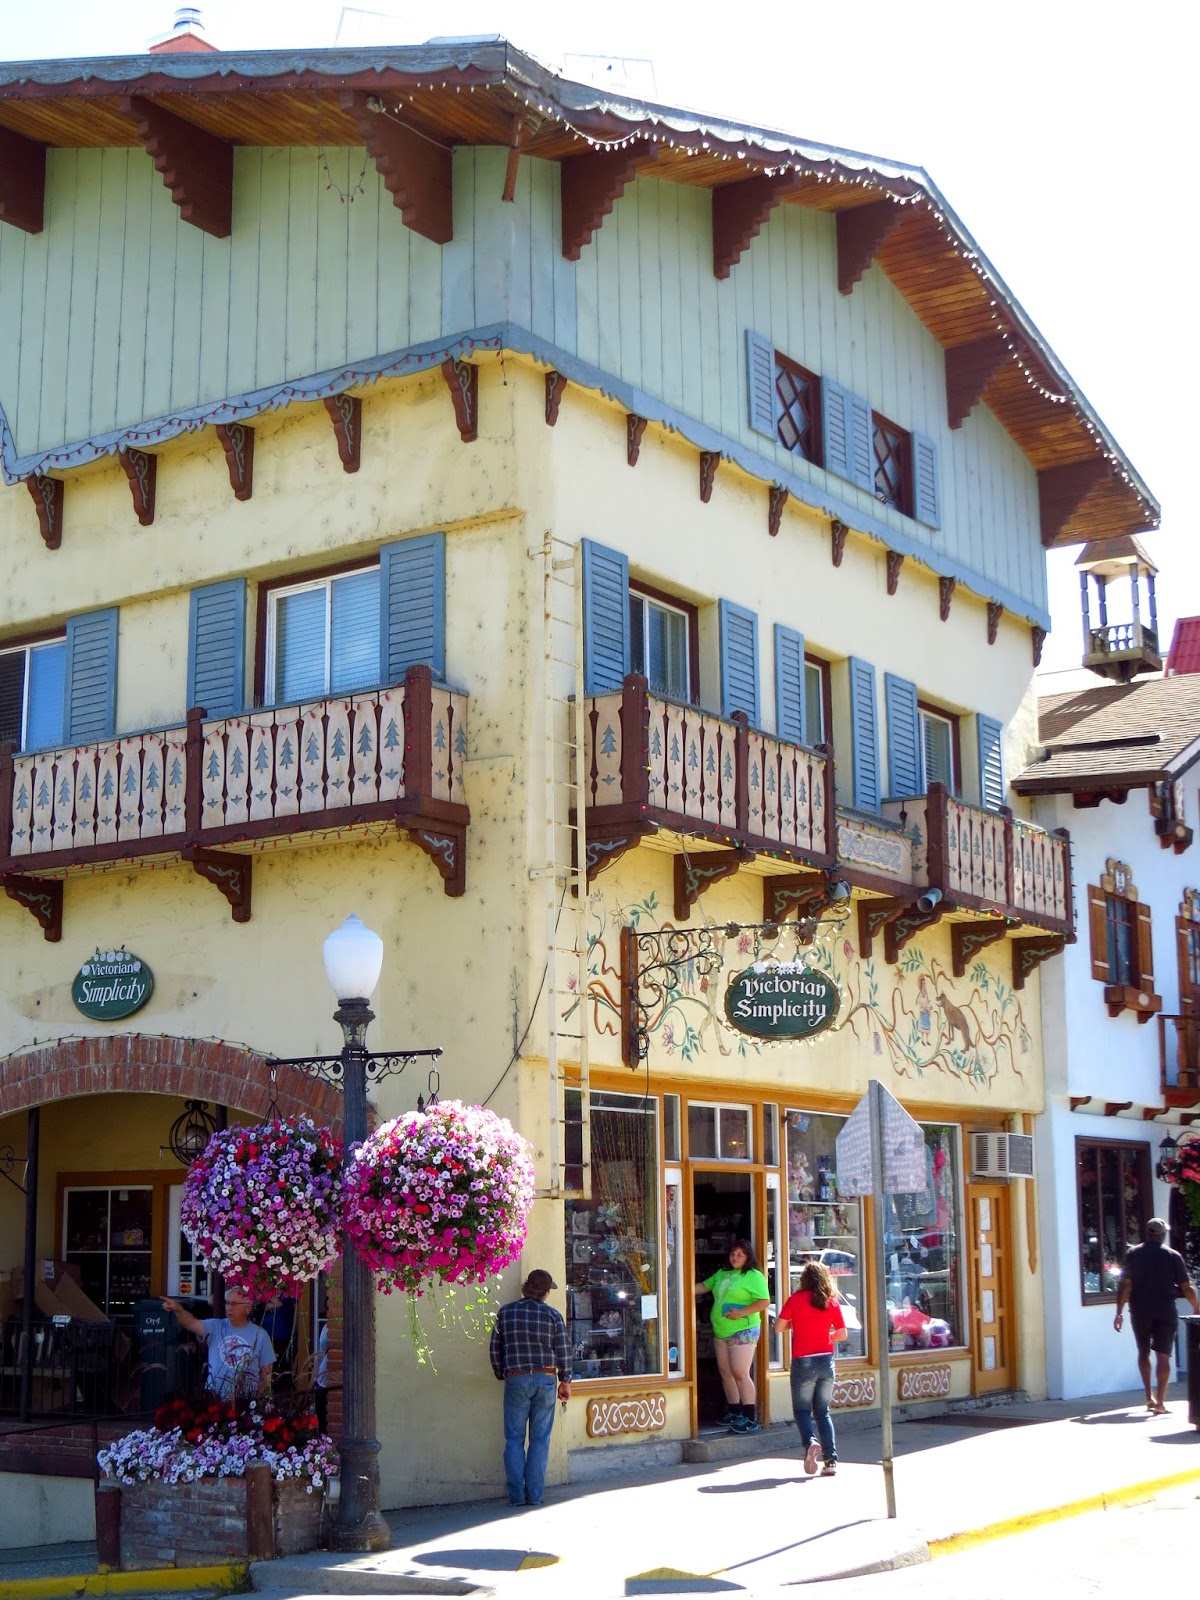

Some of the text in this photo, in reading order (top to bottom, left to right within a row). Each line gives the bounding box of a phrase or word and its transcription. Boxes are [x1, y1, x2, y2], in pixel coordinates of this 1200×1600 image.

[90, 962, 134, 976] Victorian
[78, 977, 146, 1007] Simplicity
[740, 975, 826, 998] Victorian
[732, 998, 827, 1027] Simplicity
